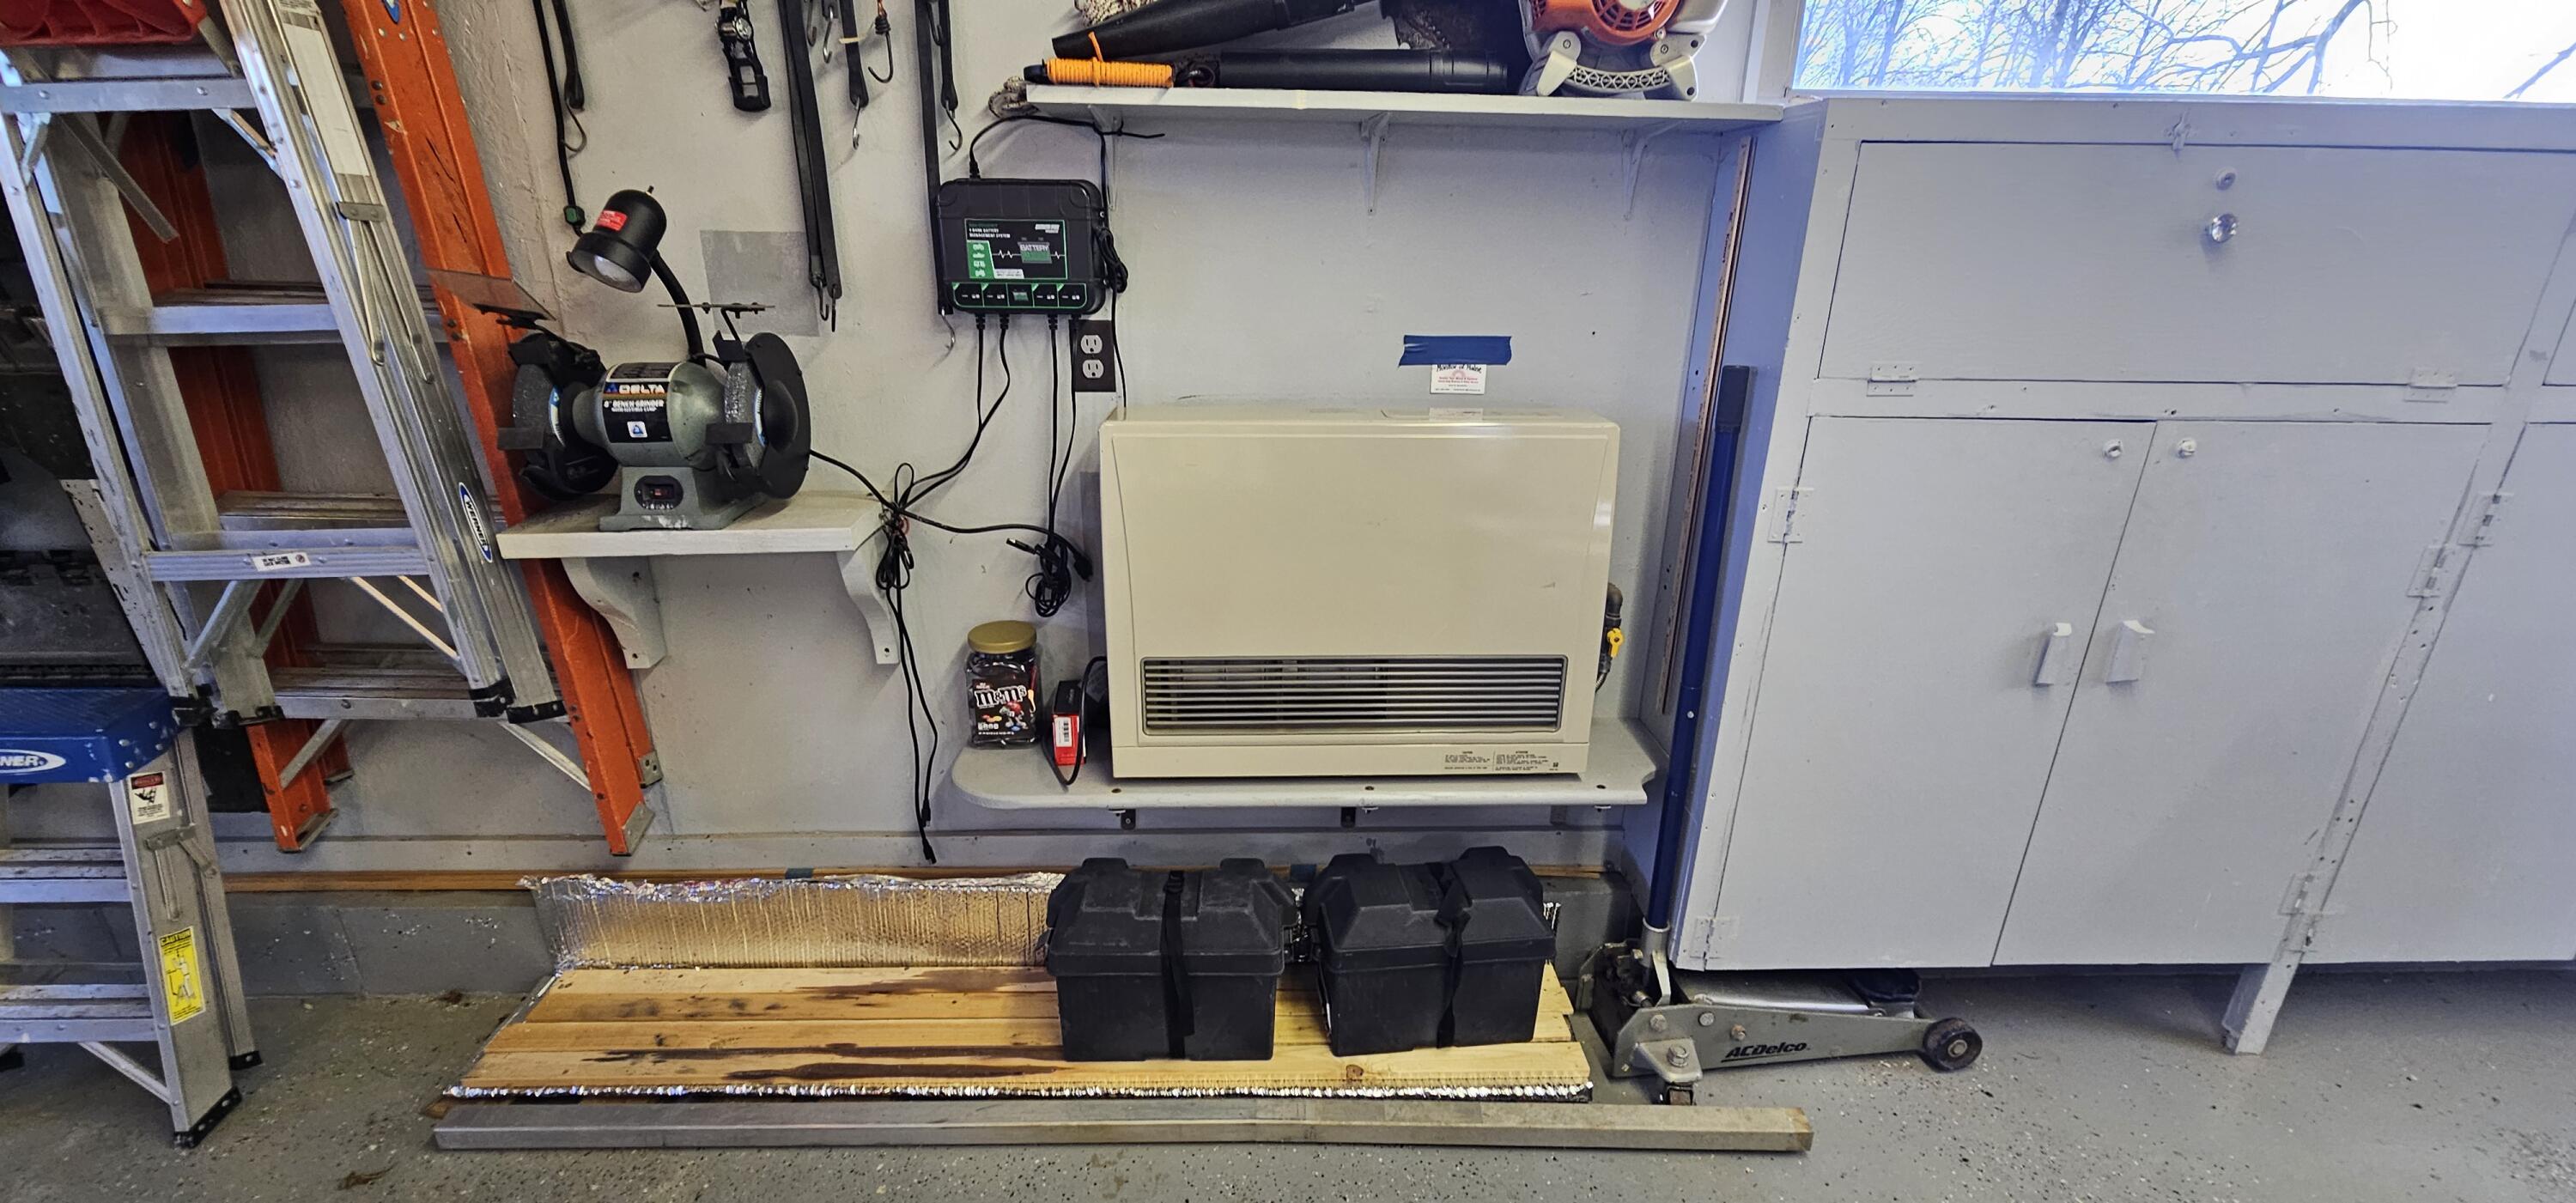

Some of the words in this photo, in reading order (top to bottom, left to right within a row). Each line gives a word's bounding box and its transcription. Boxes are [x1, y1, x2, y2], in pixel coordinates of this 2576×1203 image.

[619, 384, 665, 394] DELTA
[635, 399, 665, 408] GRINDER
[465, 501, 489, 546] WERNER
[160, 929, 191, 946] CAUTION
[1726, 1042, 1807, 1058] ACDelco
